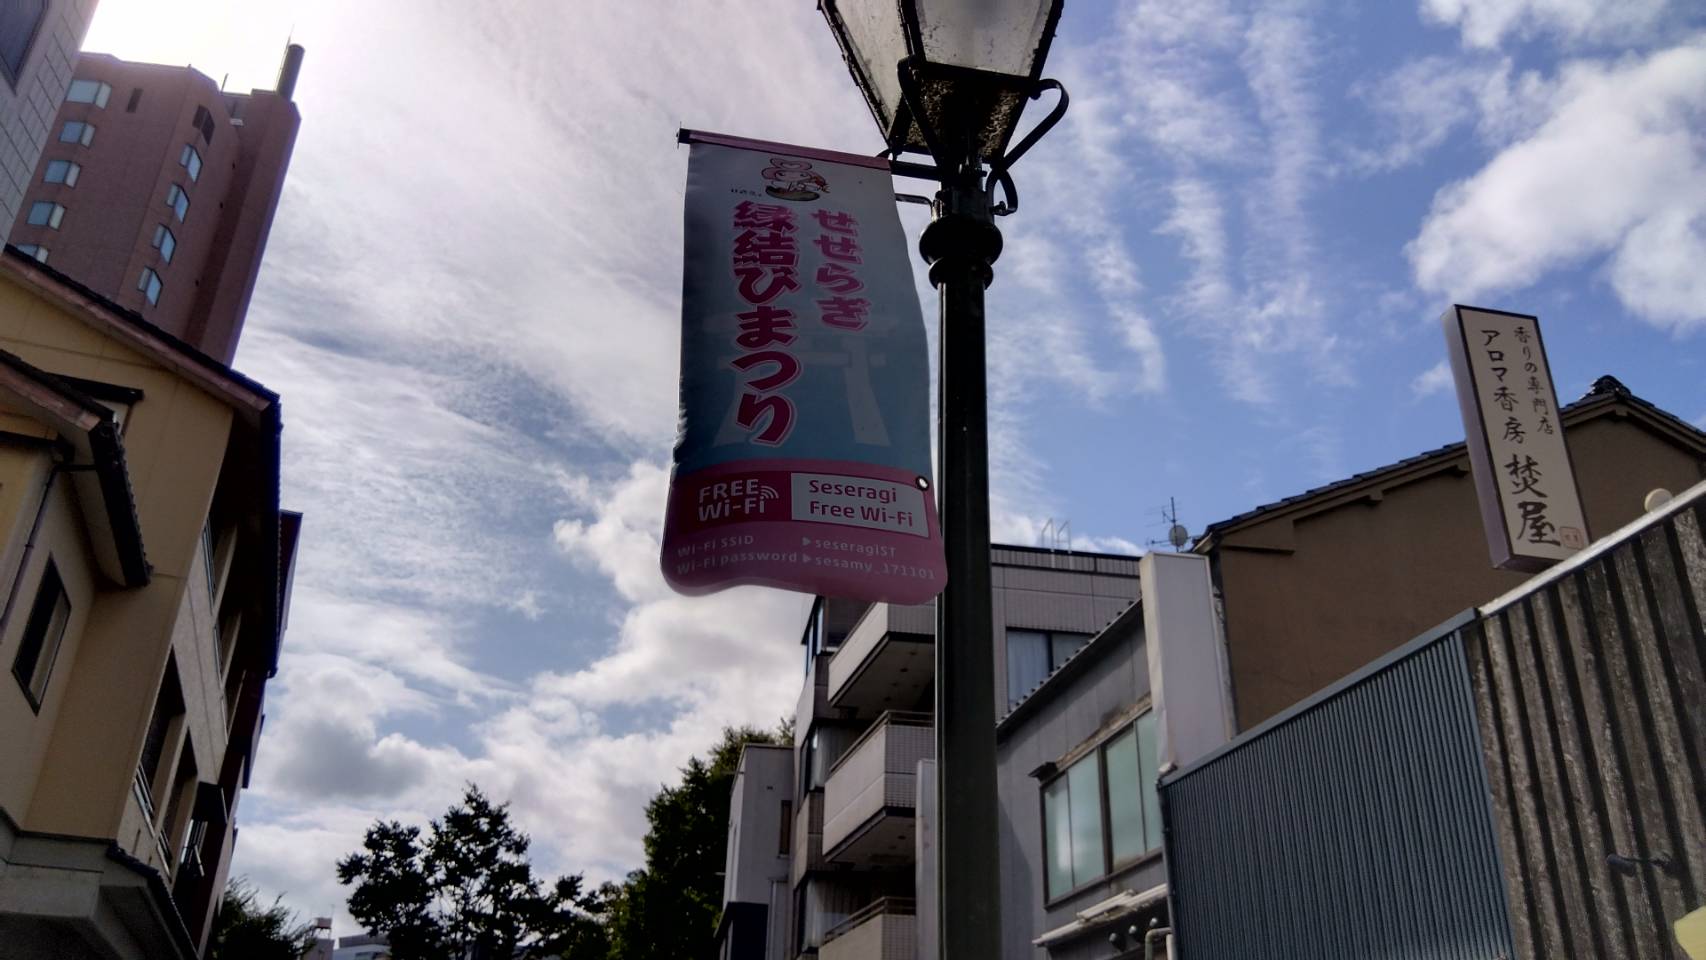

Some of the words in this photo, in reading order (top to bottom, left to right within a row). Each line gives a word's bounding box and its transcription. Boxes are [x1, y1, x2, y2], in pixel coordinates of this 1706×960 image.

[810, 207, 872, 332] せせらぎ
[731, 199, 801, 446] 縁結びまつり
[1514, 326, 1554, 435] 香りの専門店
[699, 478, 760, 503] FREE
[808, 480, 897, 504] Seseragi
[698, 496, 766, 522] Wi-Fi
[809, 500, 855, 518] Free
[860, 505, 914, 528] Wi-Fi
[720, 535, 755, 549] SSID
[720, 551, 797, 567] password
